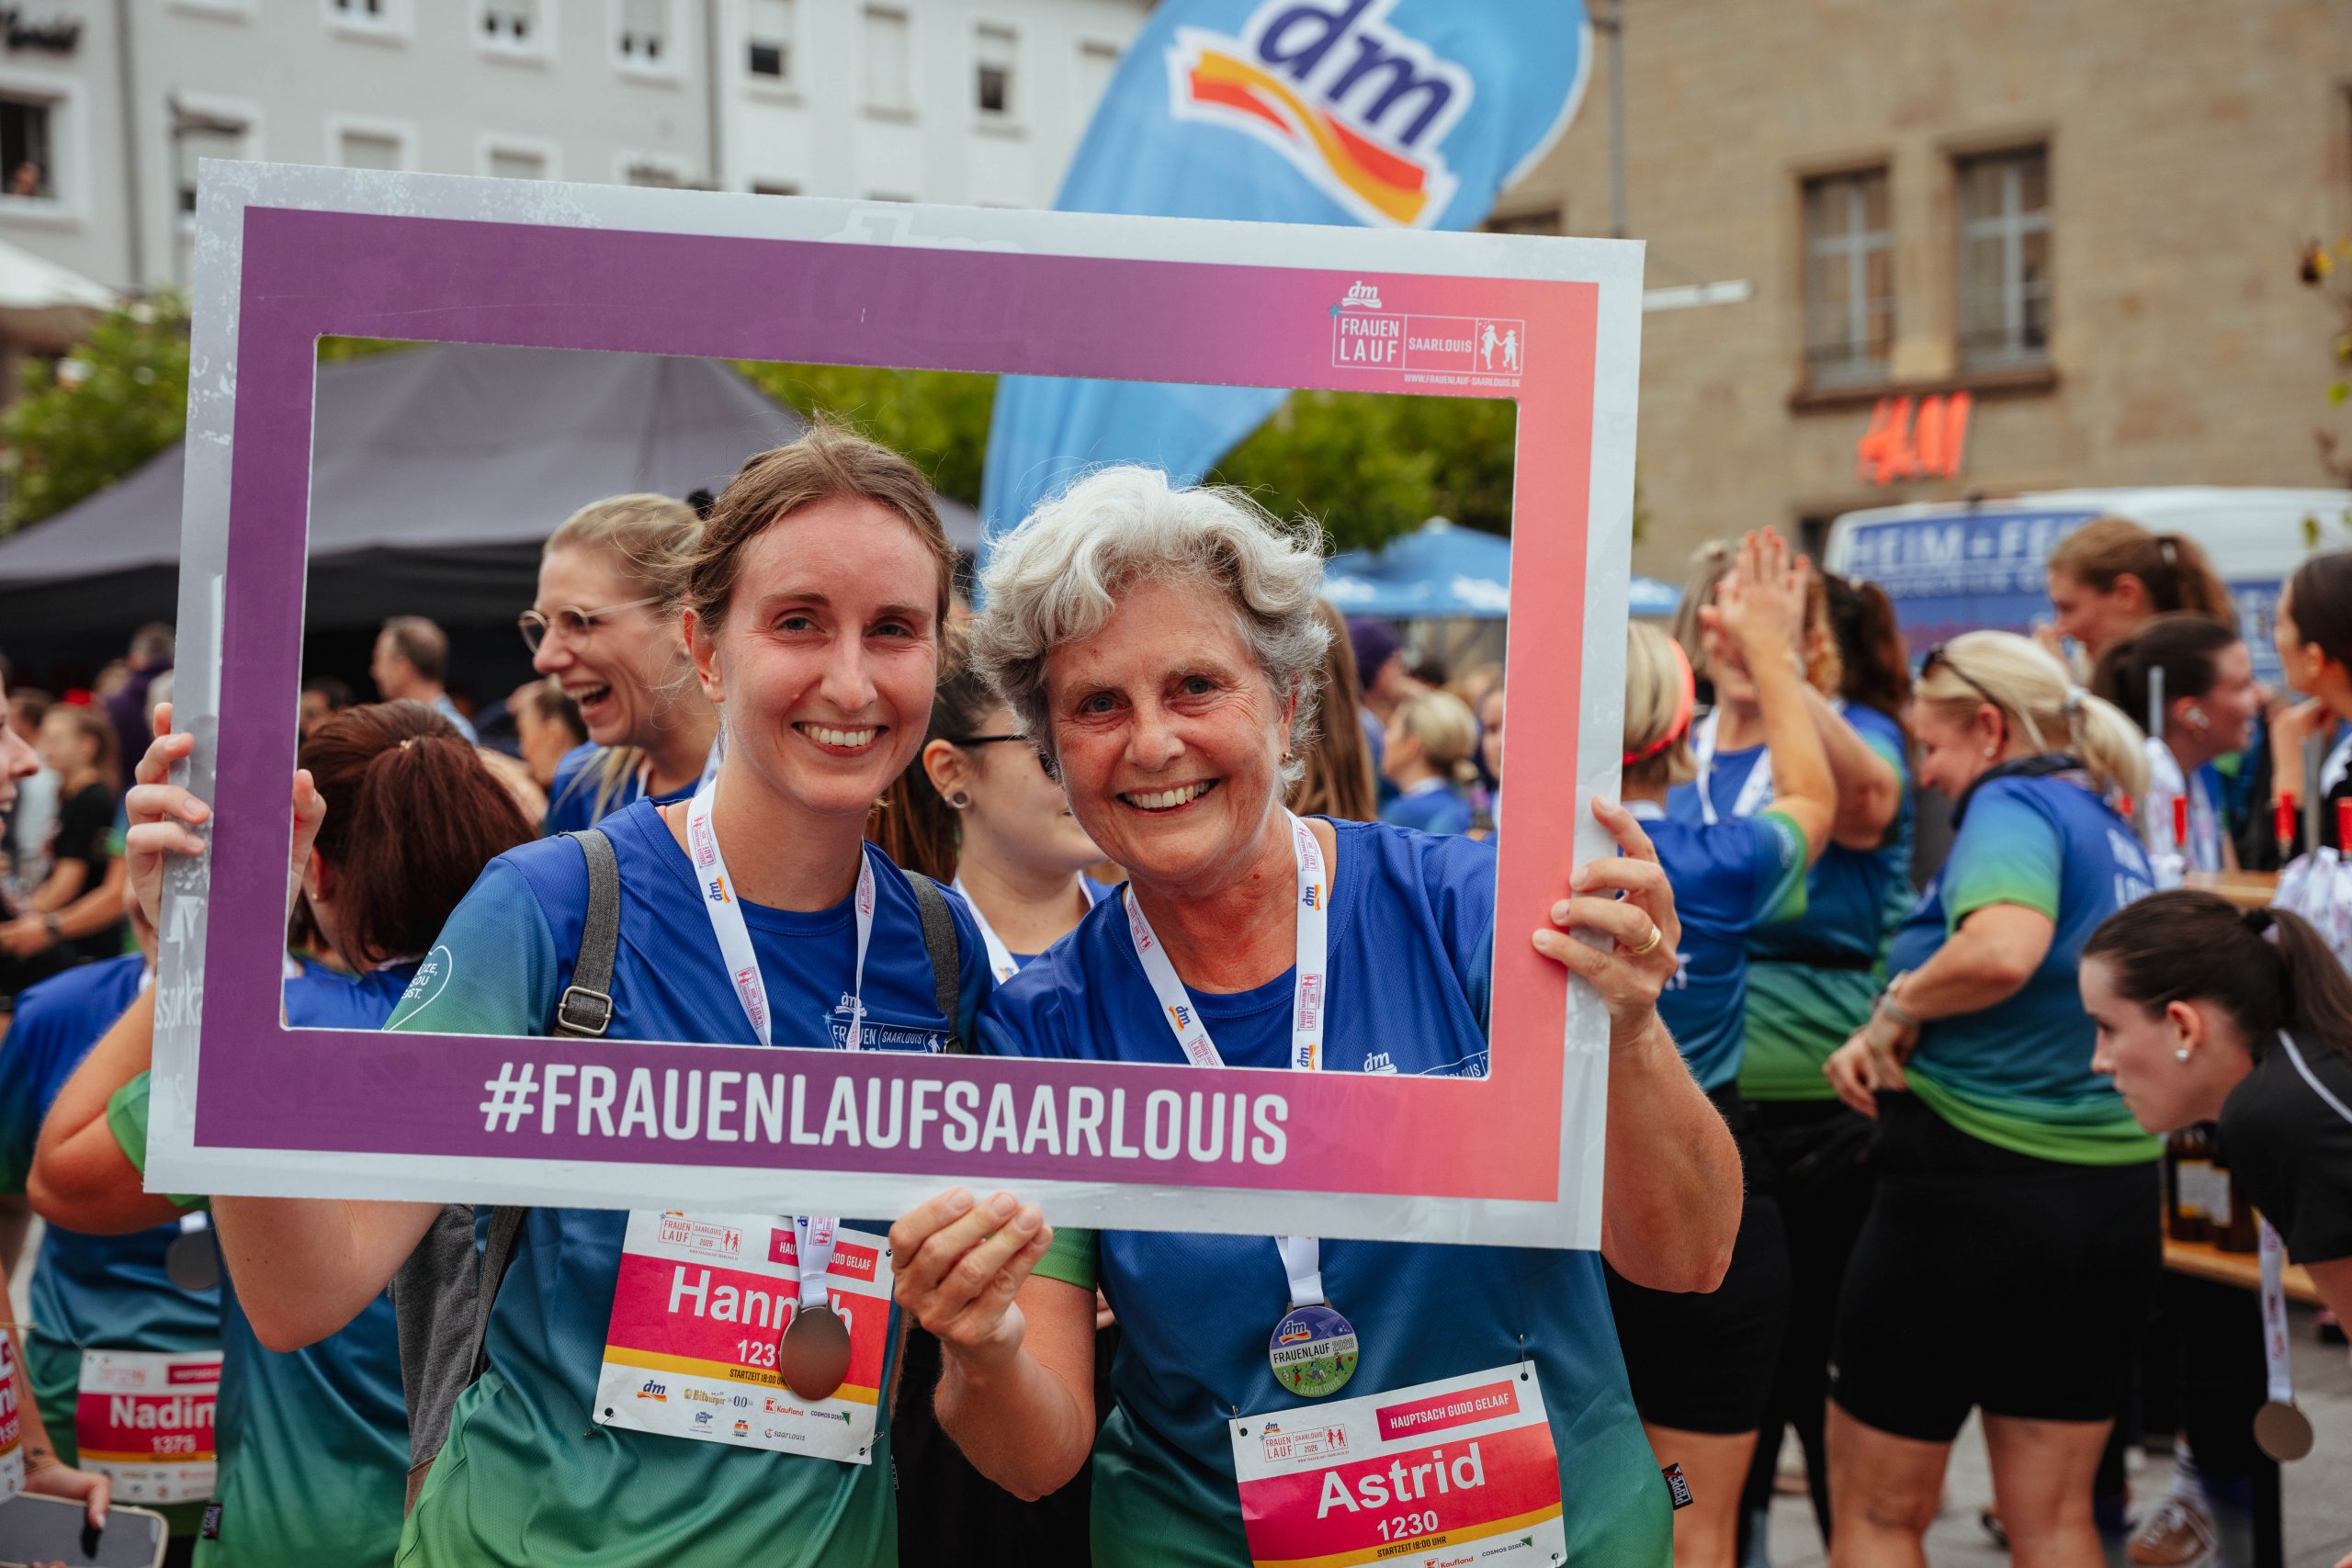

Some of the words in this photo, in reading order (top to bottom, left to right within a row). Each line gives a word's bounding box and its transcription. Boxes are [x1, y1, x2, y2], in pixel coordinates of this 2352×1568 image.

[1259, 0, 1452, 147] dm
[1348, 280, 1378, 299] dm
[1340, 318, 1399, 338] FRAUEN
[1340, 337, 1398, 363] LAUF
[1408, 337, 1472, 354] SAARLOUIS
[709, 881, 723, 901] dm
[1303, 886, 1315, 907] dm
[1176, 1005, 1191, 1026] dm
[1306, 1010, 1315, 1029] LAUF
[832, 1024, 877, 1045] FRUEN
[882, 1031, 923, 1045] SAARLOUIS
[1190, 1042, 1204, 1060] LAUF
[1297, 1047, 1309, 1067] dm
[1363, 1052, 1390, 1073] dm
[480, 1062, 1288, 1166] #FRAUENLAUFSAARLOUIS
[663, 1220, 691, 1232] FRAUEN
[695, 1225, 721, 1235] SAARLOUIS
[662, 1229, 689, 1243] LAUF
[700, 1238, 714, 1247] 2026
[830, 1252, 845, 1266] UDD
[846, 1255, 872, 1270] GELAAF
[668, 1265, 853, 1335] Hannh
[1284, 1321, 1305, 1335] dm
[737, 1339, 781, 1367] 123
[1273, 1343, 1330, 1364] FRAUENLAUF
[729, 1369, 761, 1382] STARTZEIT
[761, 1373, 776, 1384] 18:00
[643, 1380, 666, 1394] dm
[1299, 1378, 1341, 1394] SAARLOUIS
[693, 1390, 726, 1405] Bitburger
[109, 1395, 216, 1428] Nadin
[776, 1405, 804, 1416] Kaufland
[810, 1410, 831, 1419] COSMOS
[1390, 1407, 1446, 1429] HAUPTSACH
[1447, 1401, 1474, 1417] GUDD
[1475, 1393, 1510, 1411] GELAAF
[1265, 1422, 1278, 1431] dm
[1265, 1437, 1292, 1448] FRAUEN
[1295, 1431, 1323, 1442] SAARLOUIS
[1268, 1445, 1293, 1459] LAUF
[1305, 1445, 1318, 1453] 2026
[1317, 1441, 1486, 1519] Astrid
[1376, 1510, 1439, 1541] 1230
[1377, 1543, 1412, 1558] STARTZEIT
[1412, 1540, 1431, 1551] 18:00
[1432, 1536, 1448, 1547] UHR
[1482, 1548, 1508, 1558] COSMOS
[1441, 1556, 1474, 1568] Kaufland
